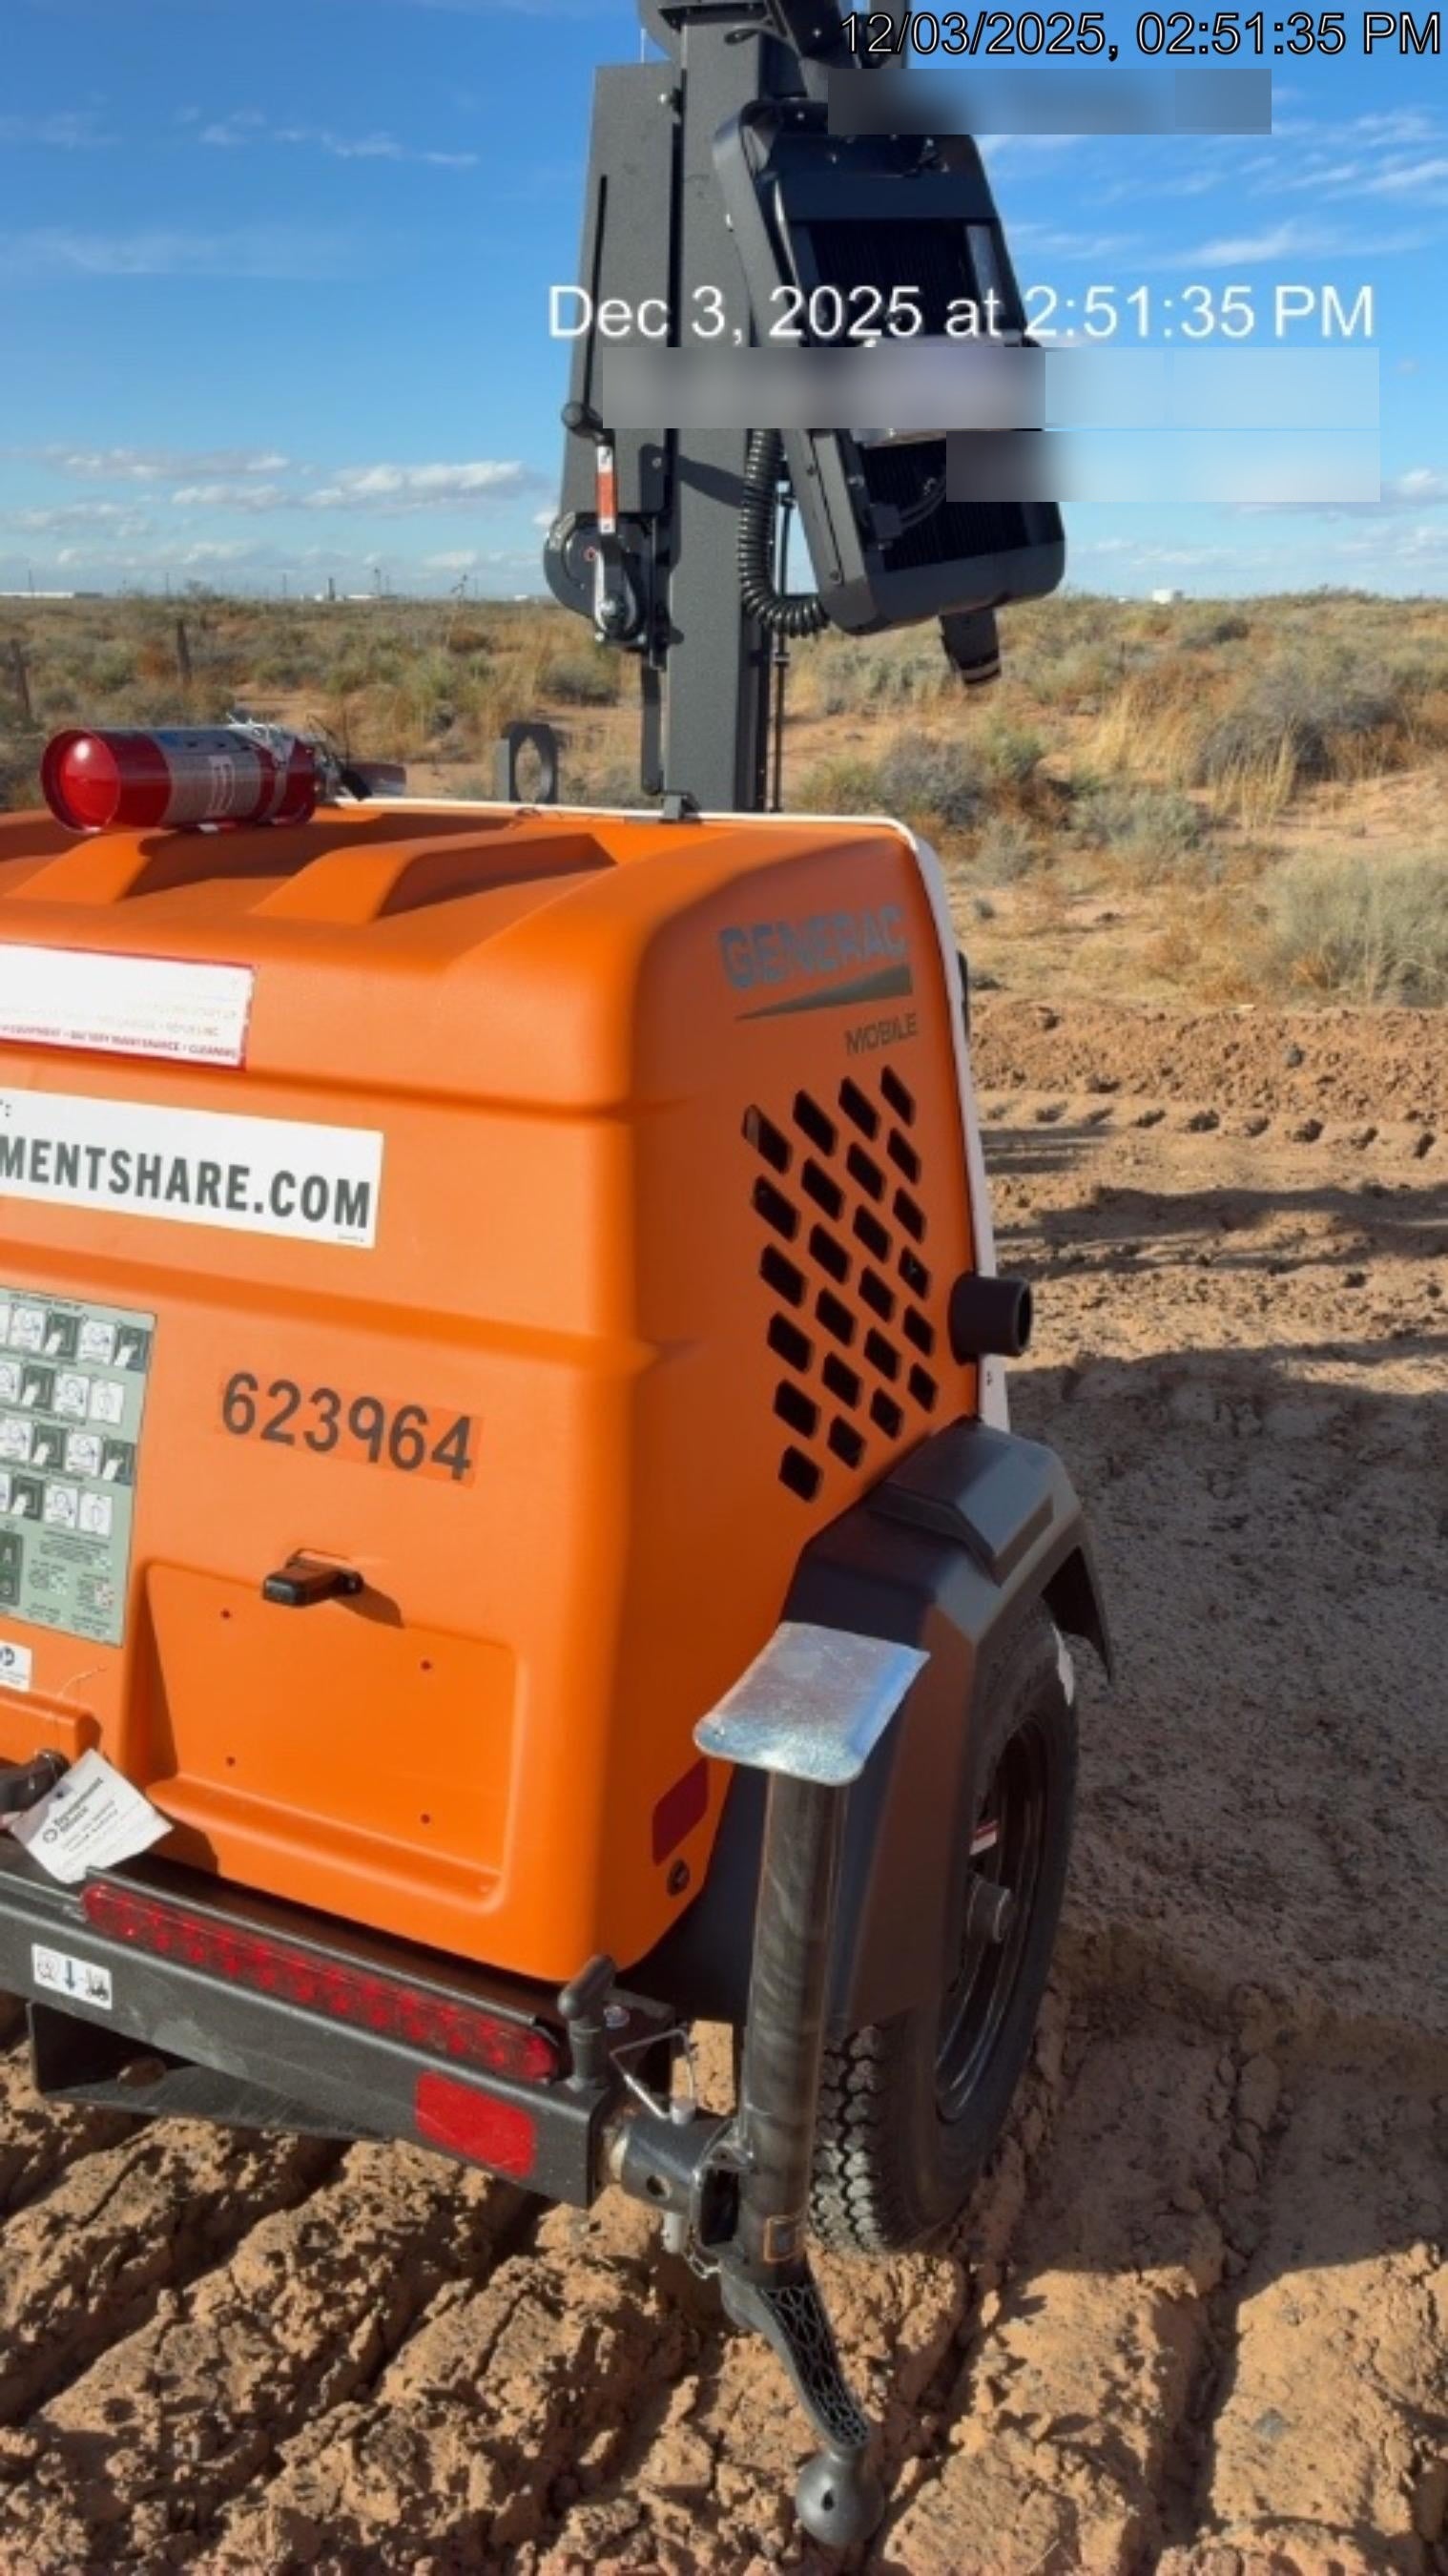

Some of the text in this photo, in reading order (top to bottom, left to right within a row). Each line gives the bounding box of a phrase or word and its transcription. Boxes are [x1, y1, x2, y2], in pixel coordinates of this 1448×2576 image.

[718, 904, 909, 989] GENERAC
[844, 1013, 917, 1055] MOBILE
[0, 1134, 371, 1229] MENTSHARE.COM
[221, 1371, 471, 1481] 623964
